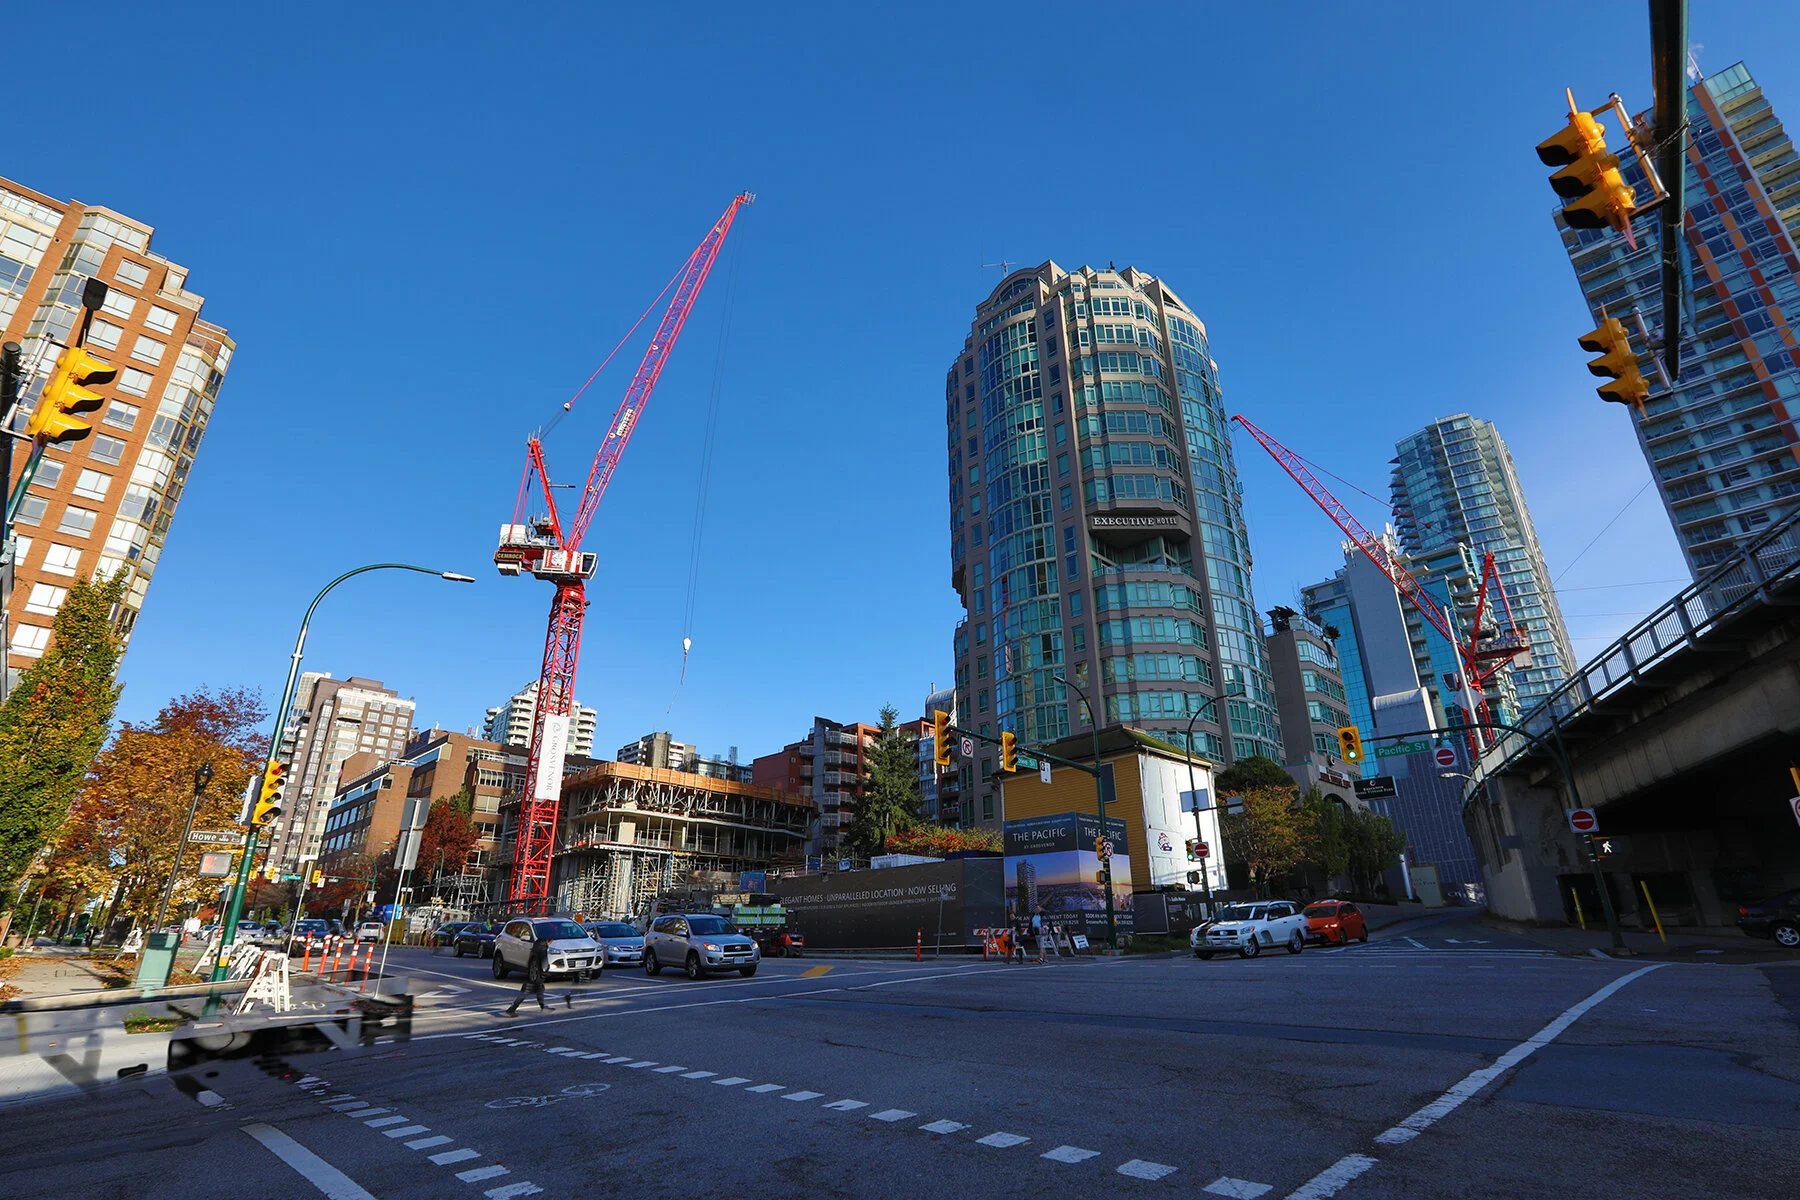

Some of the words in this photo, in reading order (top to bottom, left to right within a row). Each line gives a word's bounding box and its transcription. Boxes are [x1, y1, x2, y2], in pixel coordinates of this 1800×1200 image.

[1094, 517, 1155, 526] EXECUTIVE
[1156, 517, 1177, 525] HOTEL
[1378, 744, 1410, 756] Pacific
[1414, 743, 1426, 751] St
[546, 735, 559, 791] GROSVENOR
[192, 832, 217, 841] Howe
[1012, 832, 1029, 842] THE
[1031, 828, 1066, 840] PACIFIC
[1084, 827, 1097, 837] THE
[803, 894, 824, 903] HOMES
[826, 891, 871, 902] UNPARALLELED
[871, 888, 904, 899] LOCATION
[908, 885, 927, 896] NOW
